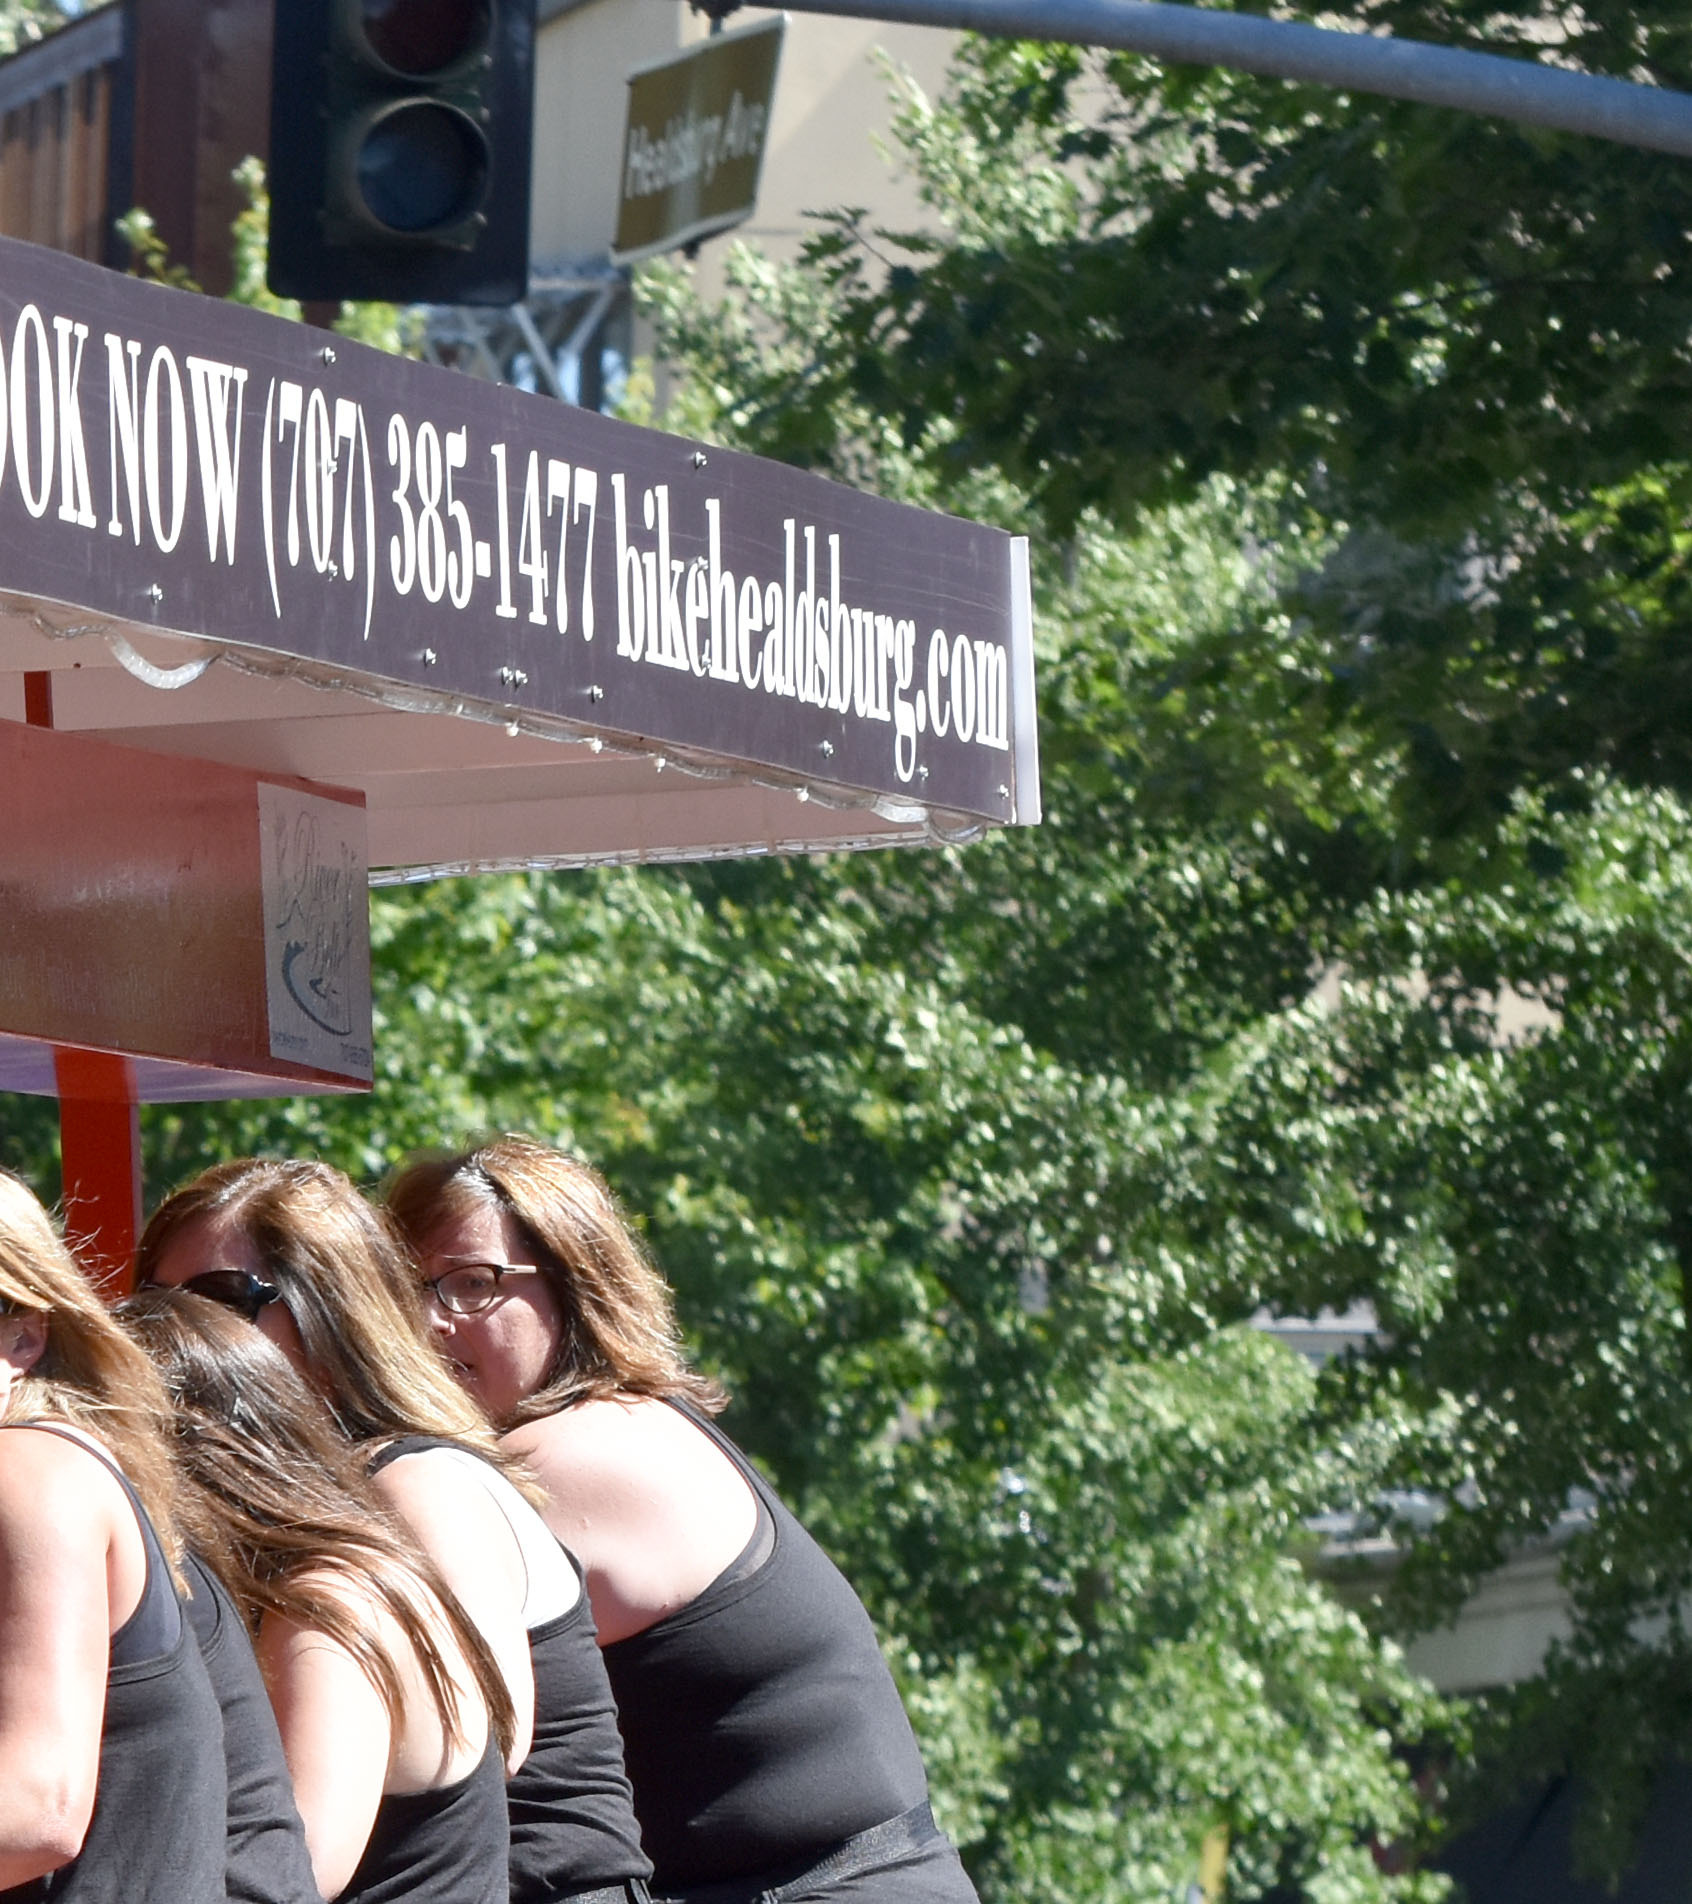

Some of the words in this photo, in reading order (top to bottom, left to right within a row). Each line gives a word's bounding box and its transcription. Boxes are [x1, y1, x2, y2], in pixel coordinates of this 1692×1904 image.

[104, 332, 249, 566] NOW
[261, 375, 376, 639] (707)
[387, 412, 597, 642] 385-1477
[612, 473, 1010, 782] bikehealdsburg.com
